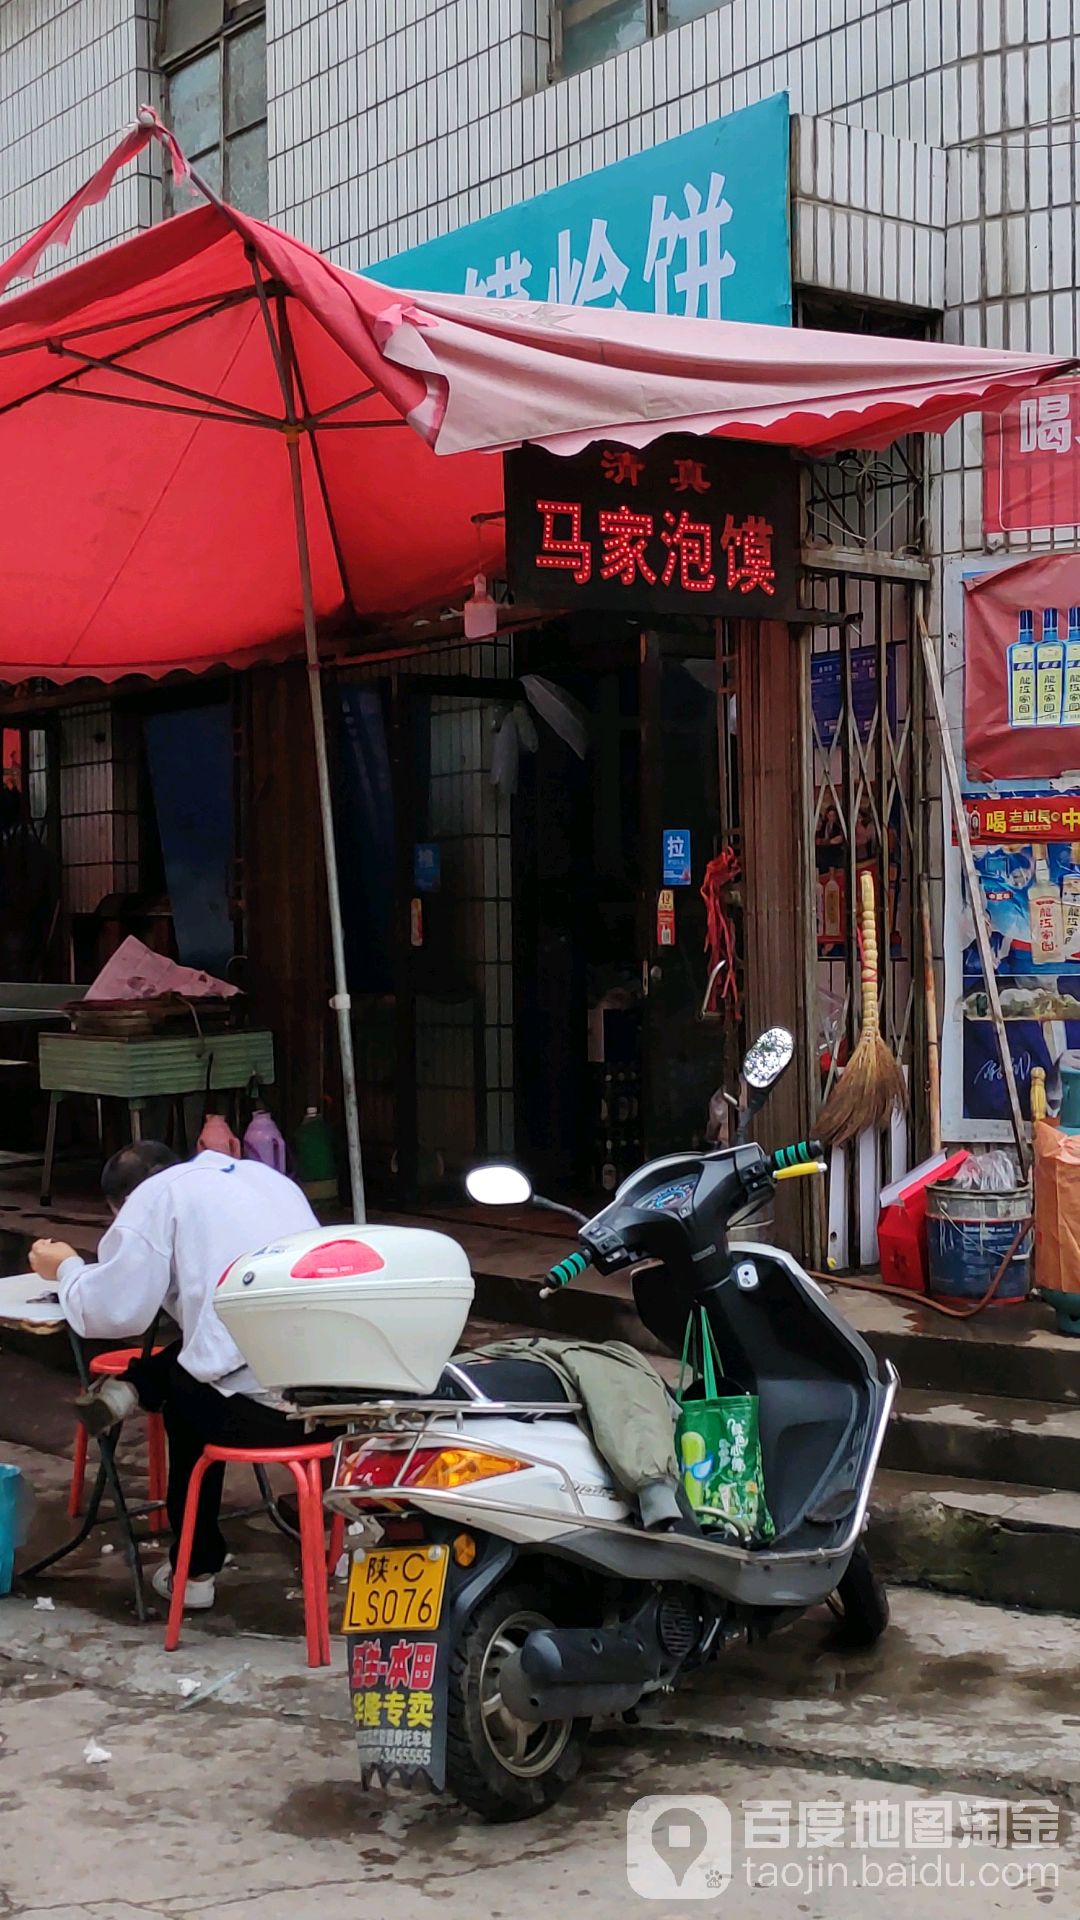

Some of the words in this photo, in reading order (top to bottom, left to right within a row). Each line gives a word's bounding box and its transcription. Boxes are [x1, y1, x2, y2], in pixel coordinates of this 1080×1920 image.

[1020, 393, 1080, 454] 喝
[536, 500, 775, 596] 马家泡馍
[667, 836, 685, 858] 拉
[349, 1588, 433, 1626] LS076
